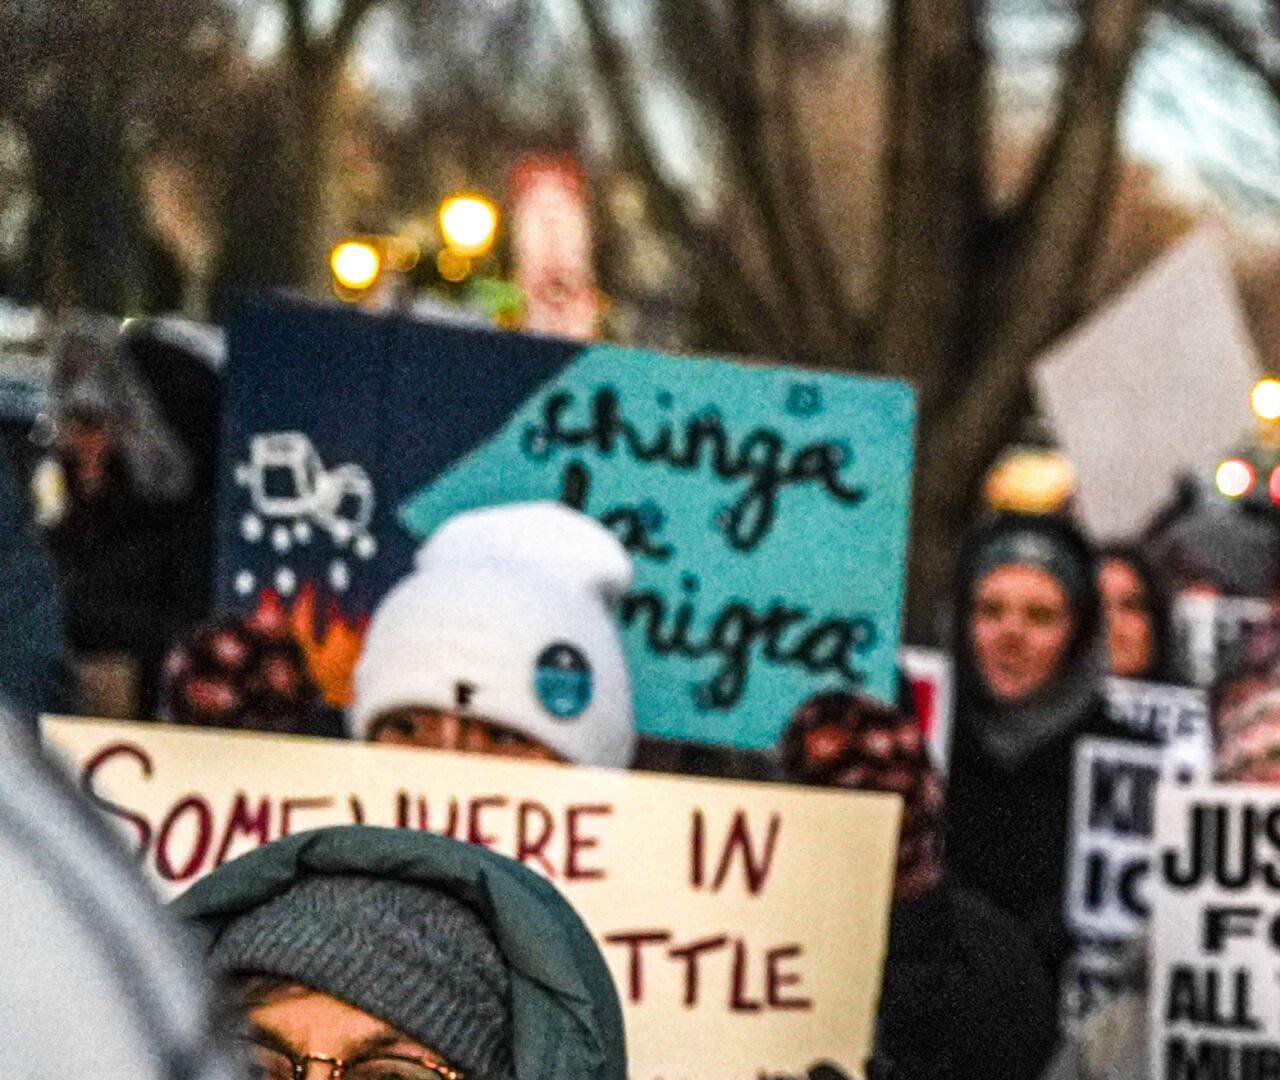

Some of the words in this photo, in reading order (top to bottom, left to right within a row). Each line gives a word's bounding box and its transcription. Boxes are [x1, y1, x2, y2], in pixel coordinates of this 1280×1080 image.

[690, 806, 784, 899] IN
[605, 928, 813, 1014] TTLE
[1166, 965, 1264, 1033] ALL
